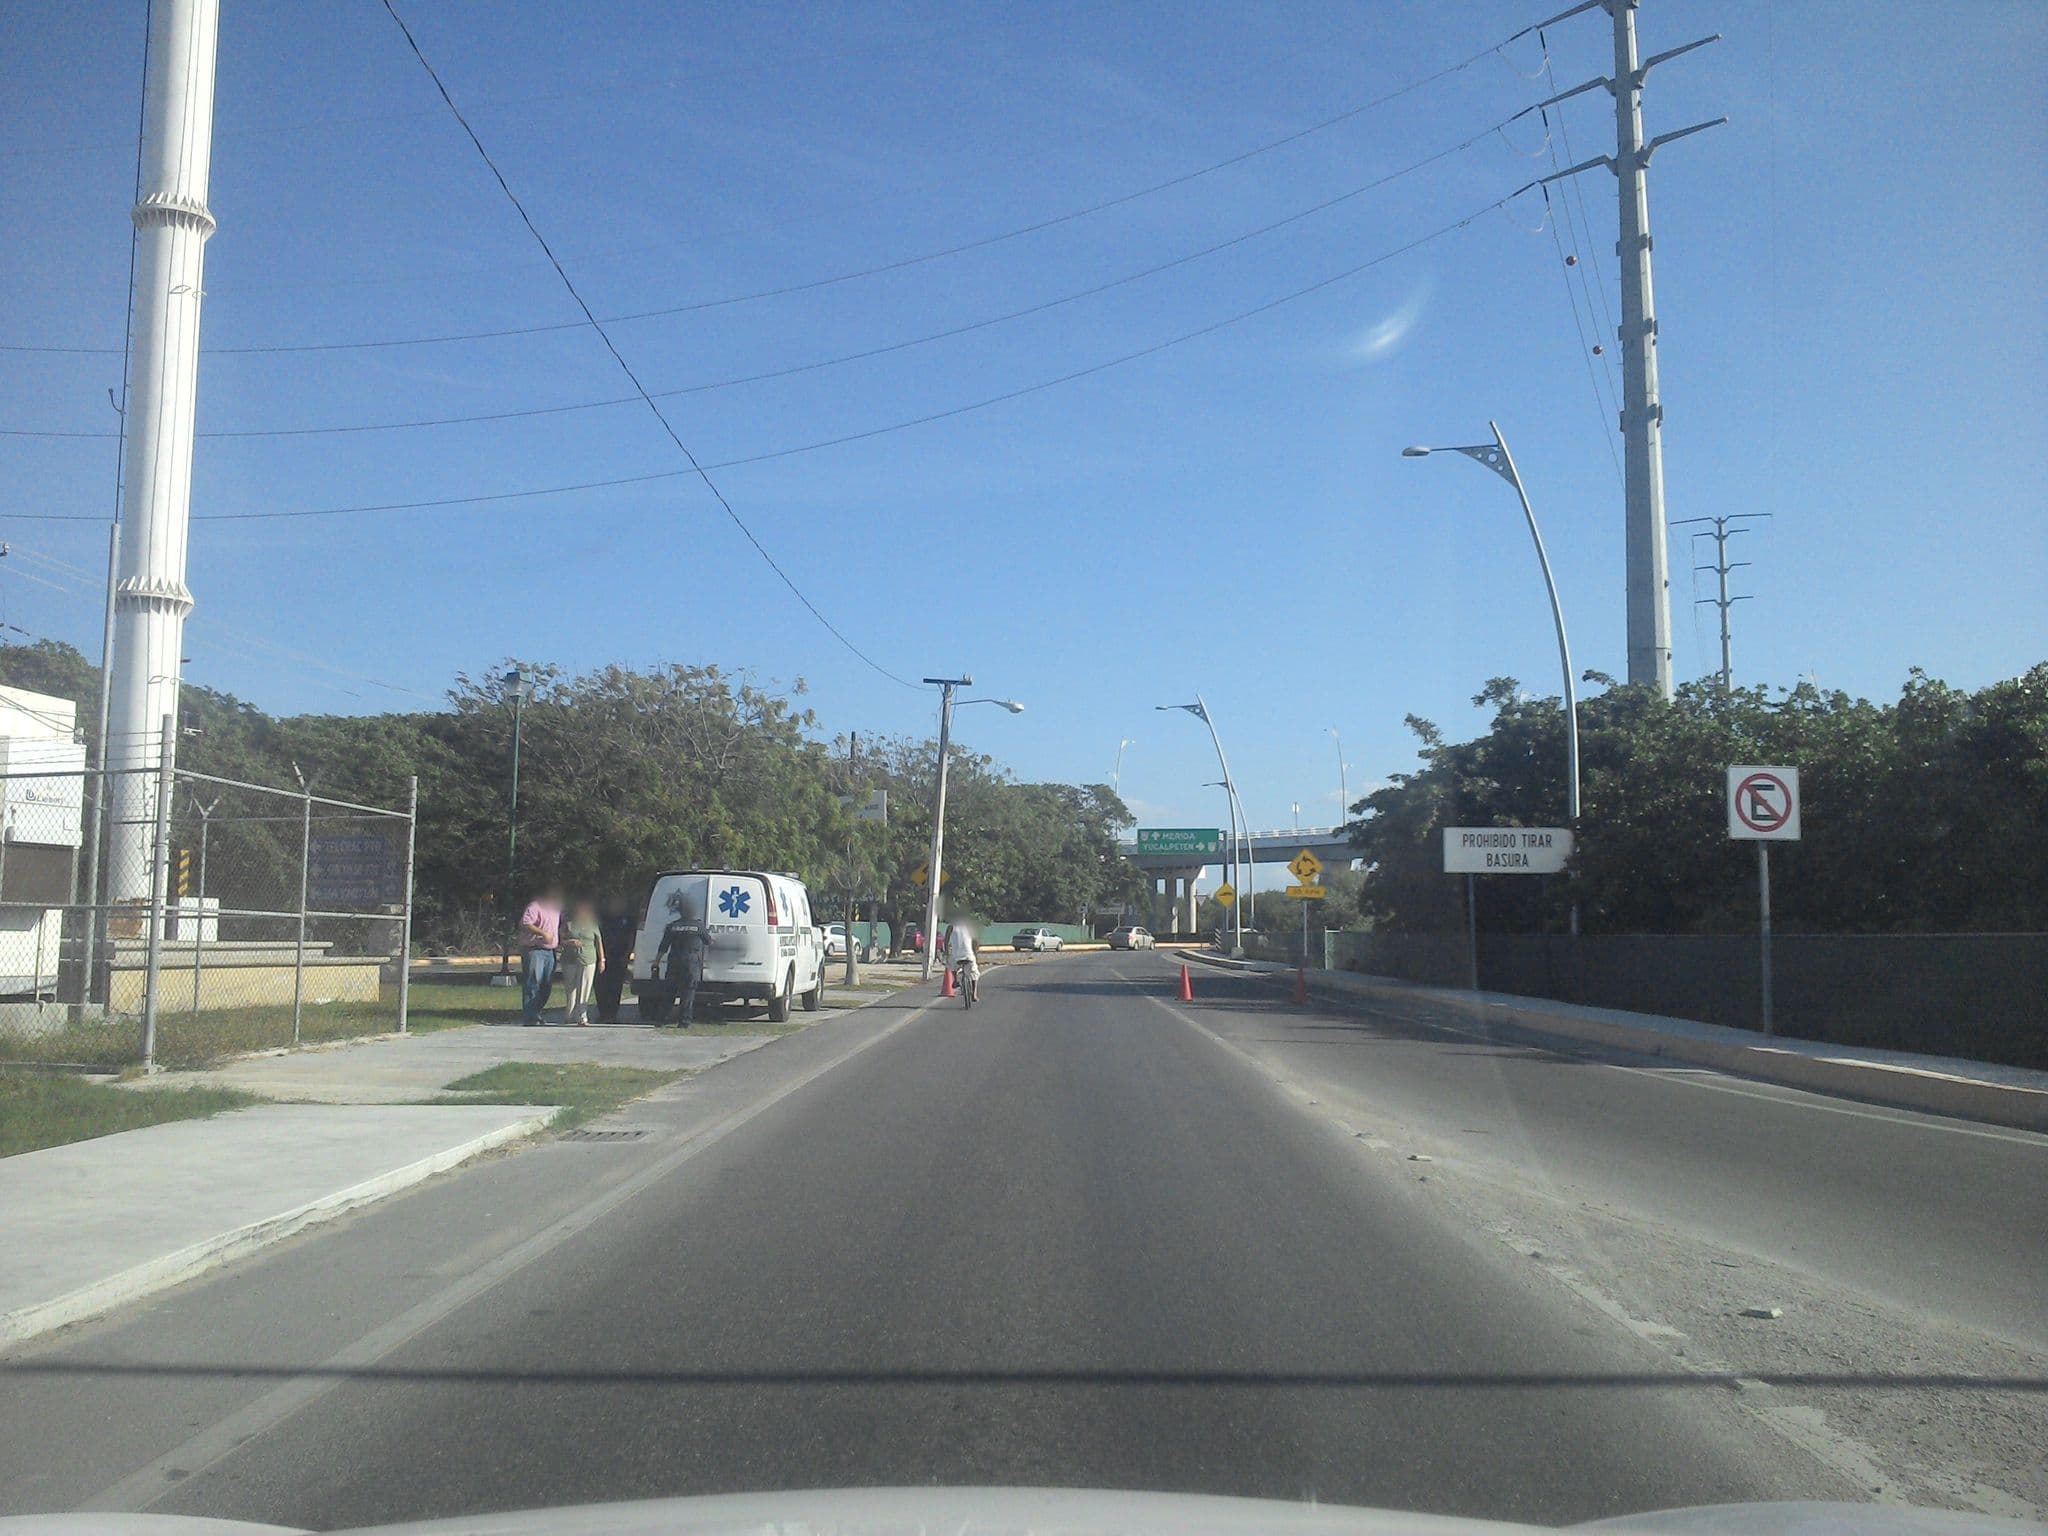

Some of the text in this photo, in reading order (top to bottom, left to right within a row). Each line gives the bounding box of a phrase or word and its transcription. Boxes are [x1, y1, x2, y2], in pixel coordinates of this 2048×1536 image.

[1750, 784, 1777, 821] E
[1162, 832, 1196, 840] MERIDA
[1462, 834, 1552, 848] PROHIBIDO TIRAR
[1142, 842, 1194, 850] YUCALPETEN
[1486, 853, 1529, 867] BASURA
[707, 925, 748, 934] ANCIA
